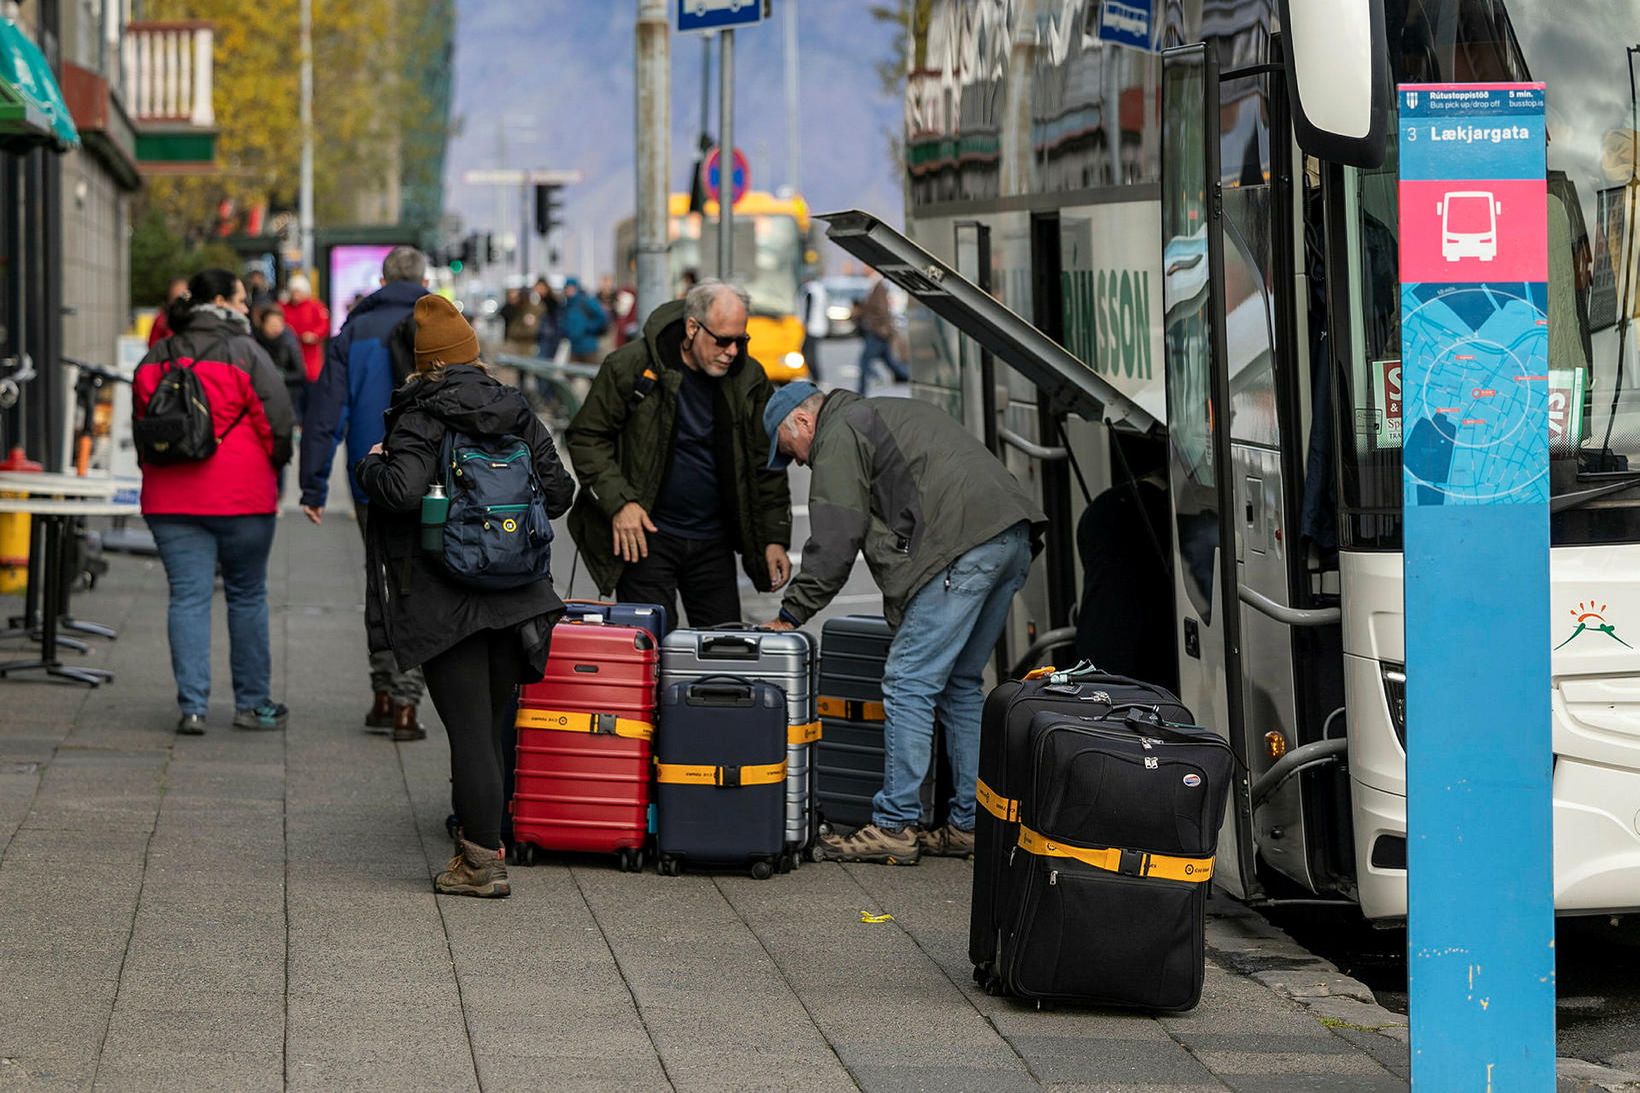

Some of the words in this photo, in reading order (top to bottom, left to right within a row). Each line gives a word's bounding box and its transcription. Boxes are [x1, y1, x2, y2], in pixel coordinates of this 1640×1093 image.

[1516, 90, 1534, 98] min.
[1430, 100, 1444, 109] Bus
[1445, 100, 1459, 110] pick
[1490, 99, 1501, 108] off
[1407, 127, 1416, 141] 3
[1431, 126, 1529, 143] Lækjargata
[1390, 402, 1399, 413] &
